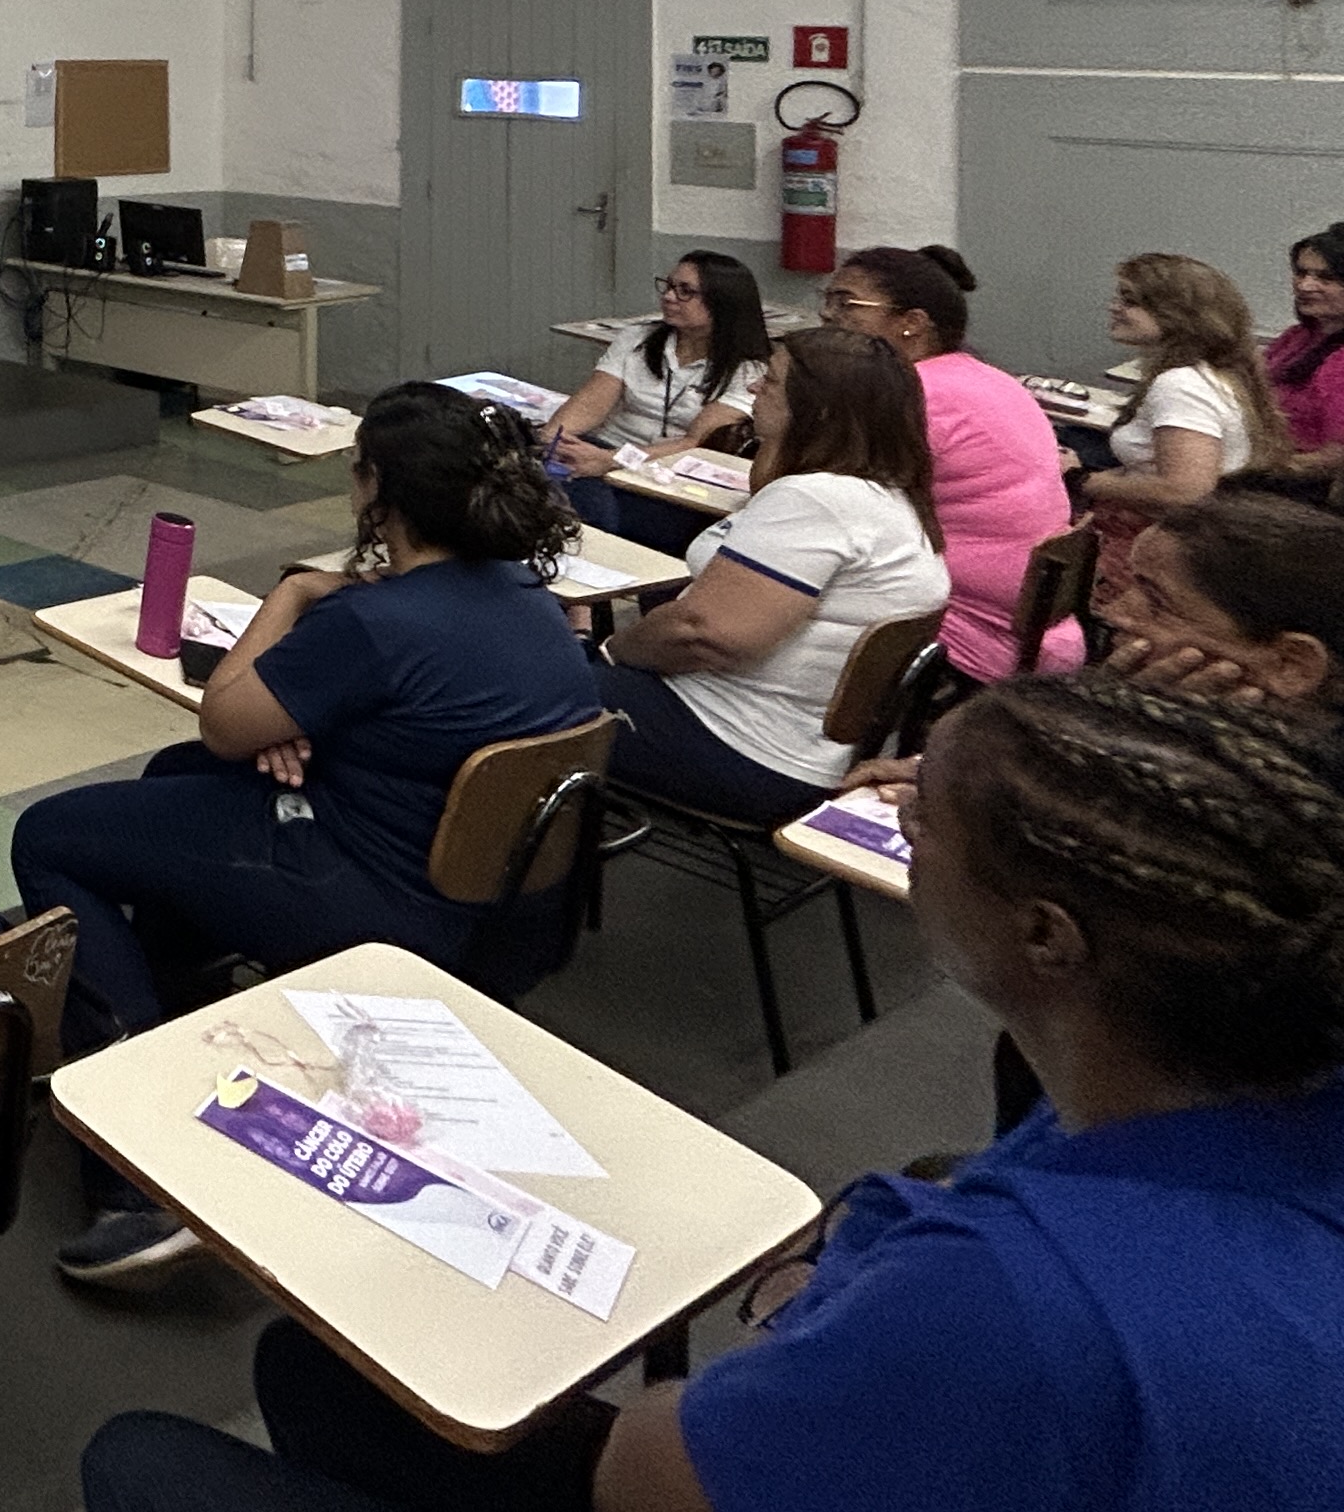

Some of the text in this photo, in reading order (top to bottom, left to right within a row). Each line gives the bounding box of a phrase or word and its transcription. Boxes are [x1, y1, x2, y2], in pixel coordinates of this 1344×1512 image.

[294, 1120, 333, 1161] CÂNCER
[310, 1131, 353, 1178] DO COLO
[337, 1142, 374, 1179] ÚTERO
[327, 1174, 350, 1195] DO
